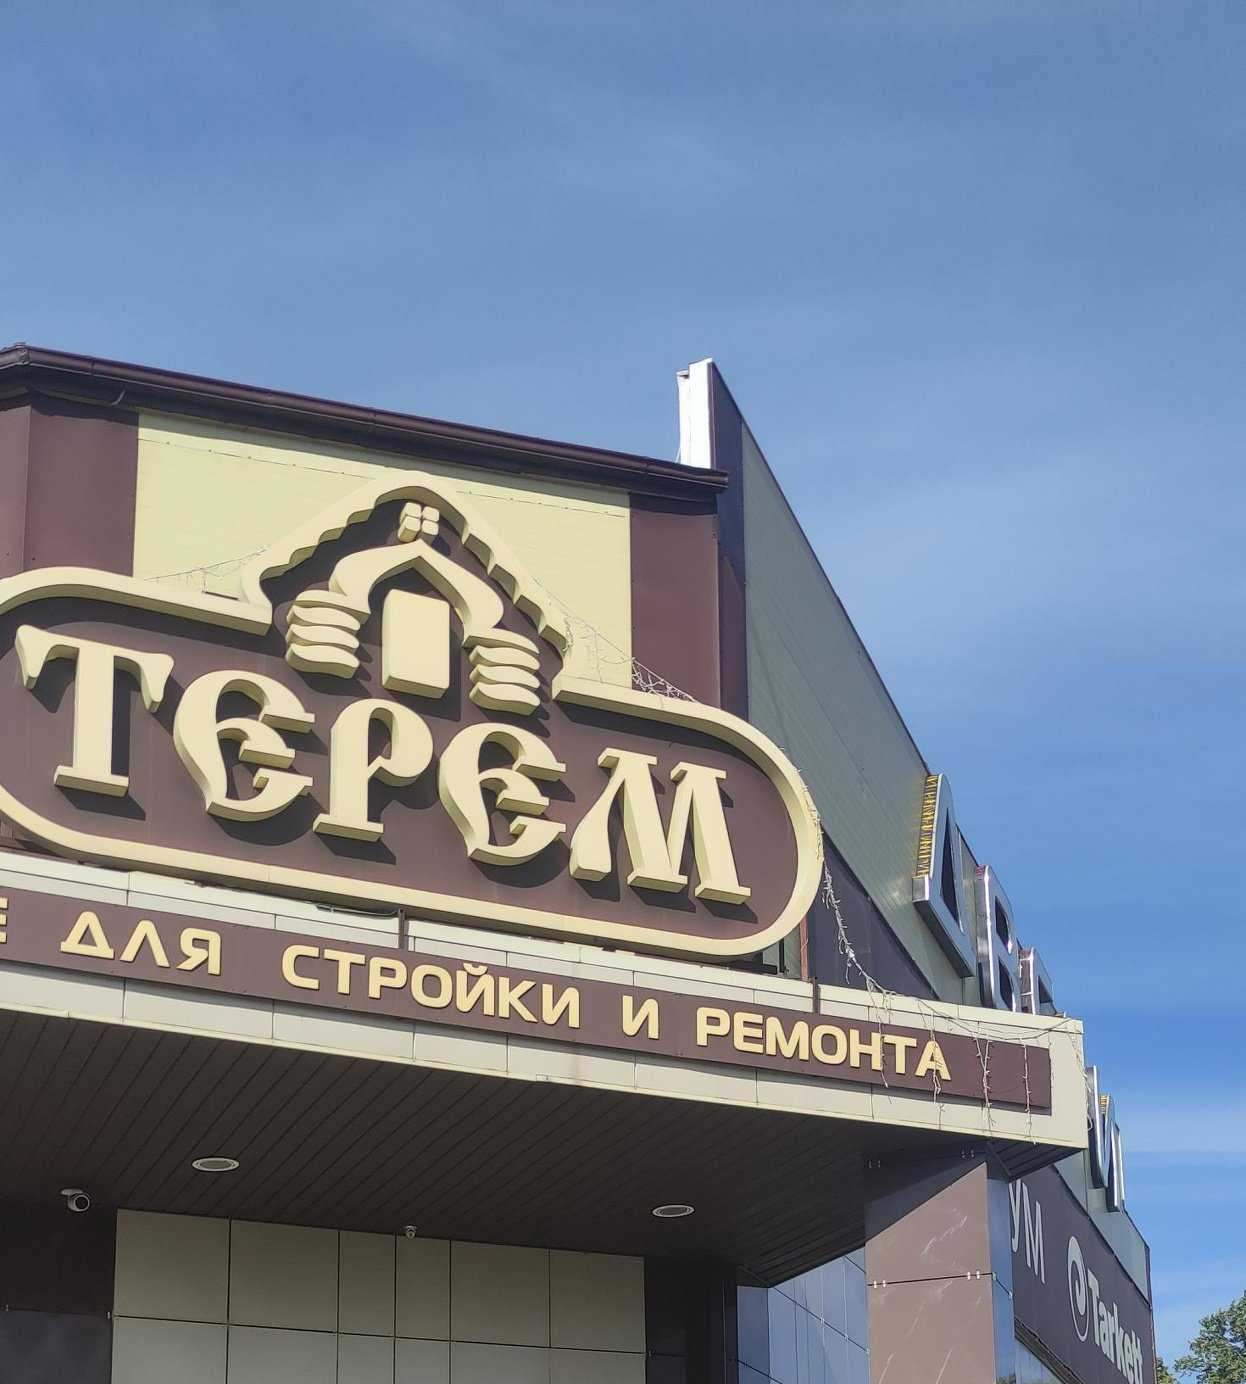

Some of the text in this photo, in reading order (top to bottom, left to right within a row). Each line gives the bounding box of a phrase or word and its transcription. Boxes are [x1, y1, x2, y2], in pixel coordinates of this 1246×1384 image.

[15, 625, 751, 905] ТЕРЕМ
[60, 911, 222, 976] ДЛЯ
[281, 944, 581, 1029] СТРОЙКИ
[622, 995, 660, 1041] И
[696, 1006, 952, 1082] РЕМОНТА
